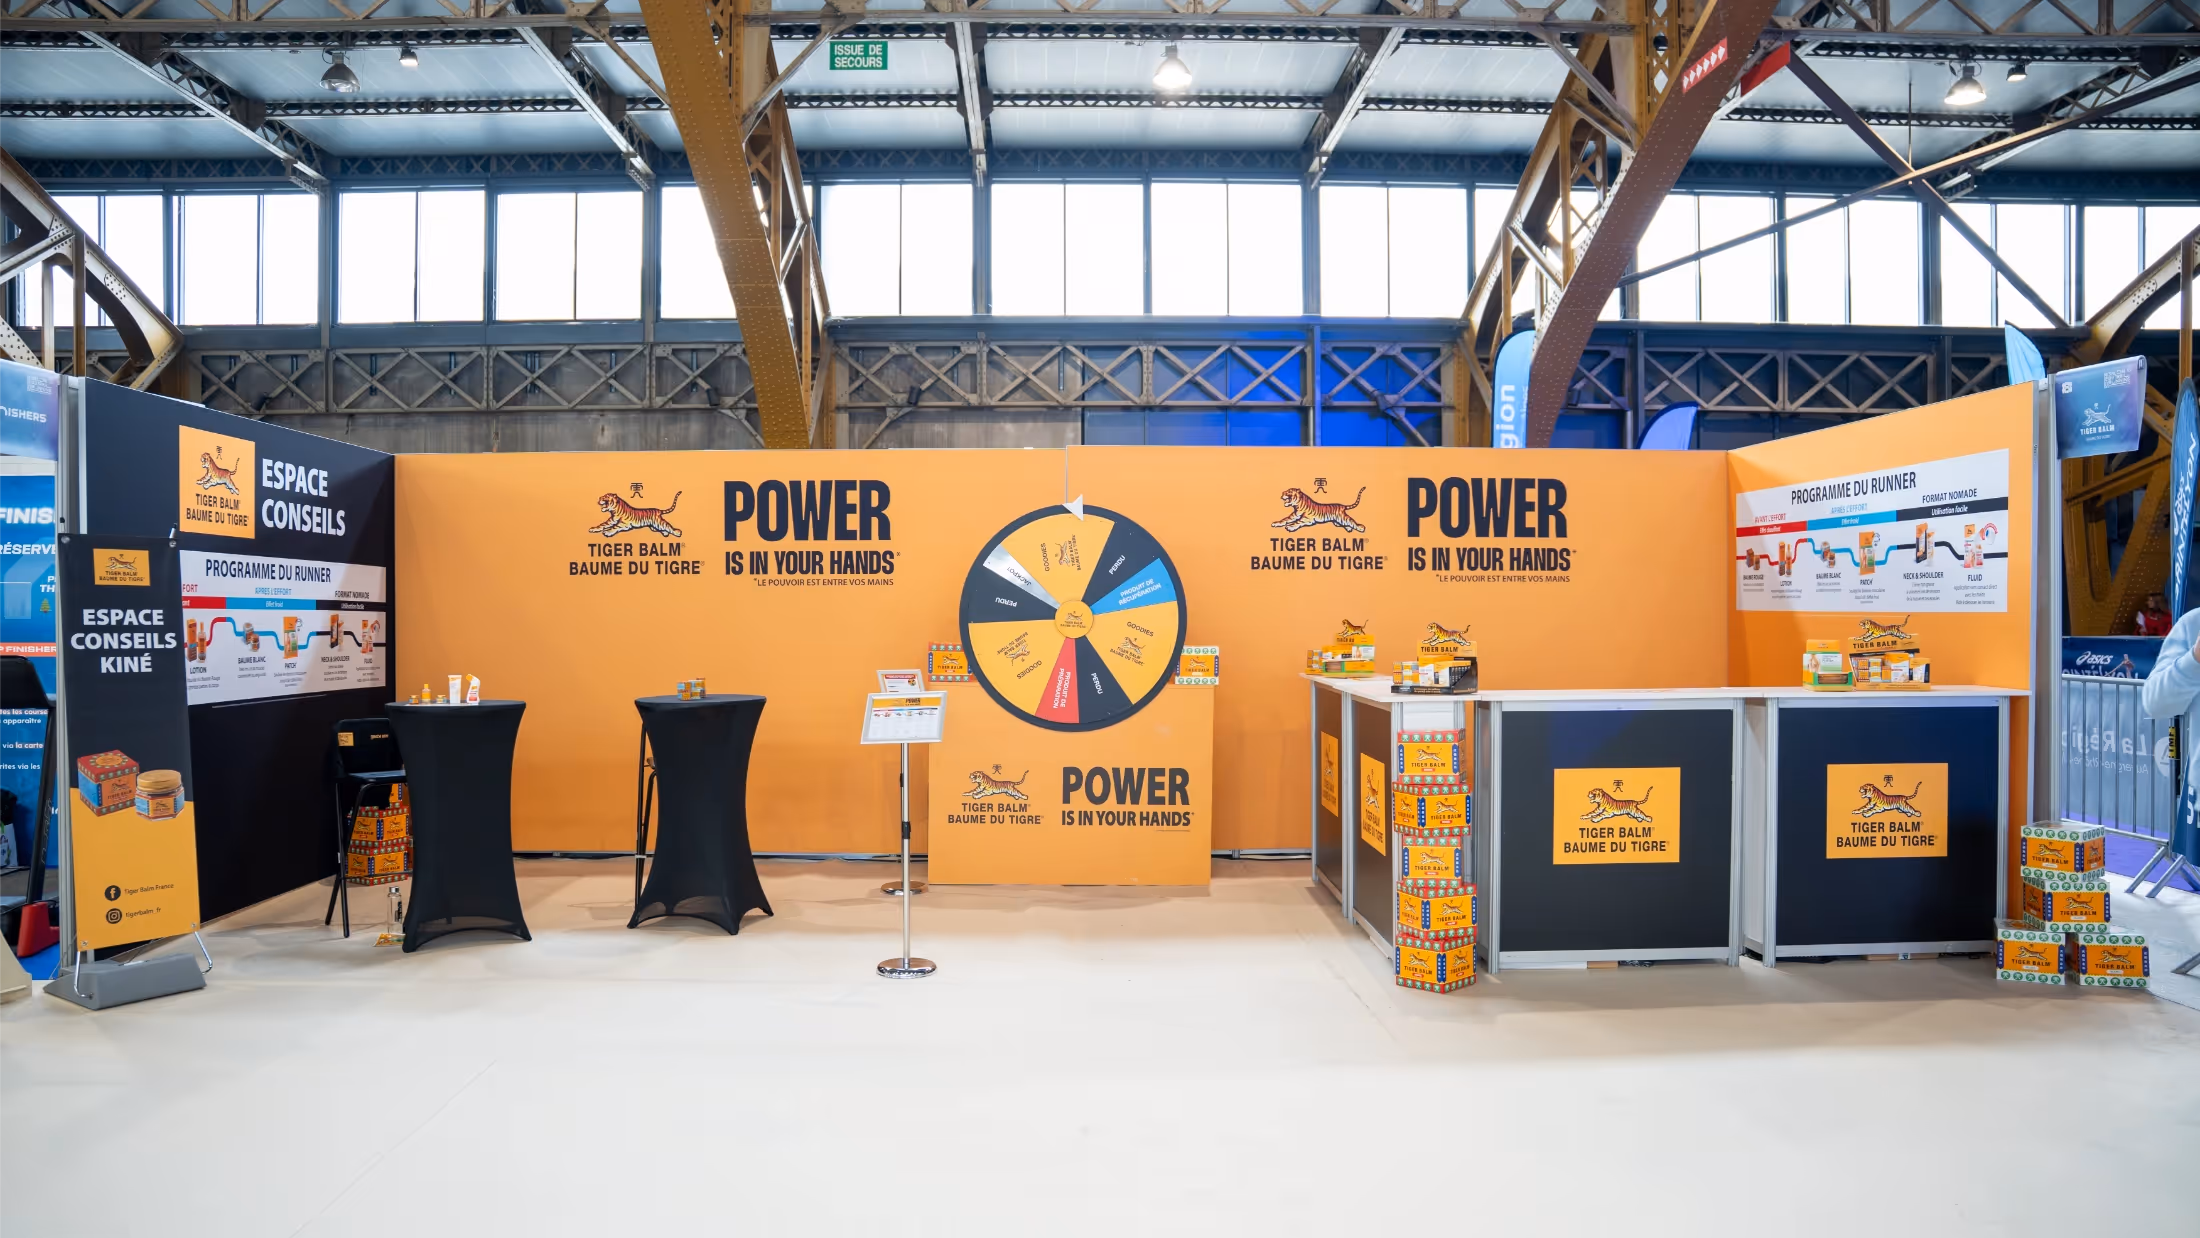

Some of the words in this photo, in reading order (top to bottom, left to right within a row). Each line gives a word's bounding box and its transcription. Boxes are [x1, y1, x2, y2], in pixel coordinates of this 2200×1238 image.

[834, 44, 864, 56] ISSUE
[869, 44, 883, 56] DE
[834, 56, 883, 68] SECOURS
[2080, 427, 2097, 435] TIGER
[2098, 424, 2115, 433] BALM
[262, 458, 328, 497] ESPACE
[1791, 481, 1851, 506] PROGRAMME
[1853, 479, 1869, 496] DU
[1871, 471, 1917, 494] RUNNER
[195, 493, 218, 508] TIGER
[1922, 492, 1947, 504] FORMAT
[1949, 488, 1978, 501] NOMADE
[724, 479, 892, 542] POWER
[1407, 476, 1568, 539] POWER
[1931, 506, 1955, 516] Utilisation
[1955, 505, 1968, 514] facile
[186, 507, 213, 523] BAUME
[214, 511, 225, 524] DU
[262, 498, 346, 537] CONSEILS
[1754, 515, 1768, 523] AVANT
[588, 543, 633, 557] TIGER
[1270, 538, 1316, 552] TIGER
[725, 551, 744, 575] IS
[749, 551, 768, 575] IN
[774, 550, 824, 575] YOUR
[1040, 542, 1050, 572] GOODIES
[1250, 556, 1305, 570] BAUME
[1311, 556, 1332, 570] DU
[1408, 546, 1426, 571] IS
[1432, 547, 1450, 571] IN
[1456, 547, 1504, 571] YOUR
[205, 558, 276, 580] PROGRAMME
[278, 564, 293, 581] DU
[294, 566, 331, 583] RUNNER
[569, 561, 622, 575] BAUME
[628, 561, 649, 575] DU
[1108, 555, 1126, 575] PERDU
[768, 578, 805, 586] POUVOIR
[806, 578, 821, 586] EST
[822, 578, 848, 586] ENTRE
[849, 578, 866, 586] VOS
[867, 578, 894, 586] MAINS
[1006, 566, 1032, 586] JACKPOT
[1903, 572, 1915, 580] NECK
[1919, 571, 1944, 579] SHOULDER
[335, 590, 352, 598] FORMAT
[352, 591, 370, 599] NOMADE
[1120, 581, 1145, 598] PRODUIT
[1145, 578, 1154, 586] DE
[994, 597, 1018, 607] PERDU
[82, 608, 165, 626] ESPACE
[1126, 621, 1154, 637] GOODIES
[70, 632, 178, 650] CONSEILS
[1876, 640, 1898, 648] BALM
[100, 652, 153, 674] KINÉ
[1016, 660, 1043, 680] GOODIES
[1062, 671, 1071, 698] PRODUIT
[1091, 672, 1103, 695] PERDU
[1060, 697, 1067, 708] DE
[2, 717, 42, 725] apparaître
[2, 741, 14, 749] via
[15, 740, 23, 749] la
[17, 762, 29, 770] via
[30, 762, 41, 770] les
[1062, 766, 1190, 806] POWER
[961, 802, 994, 813] TIGER
[948, 814, 986, 824] BAUME
[990, 814, 1005, 824] DU
[1061, 810, 1075, 826] IS
[1078, 810, 1093, 826] IN
[1096, 810, 1136, 826] YOUR
[1579, 827, 1614, 839] TIGER
[1850, 822, 1885, 834] TIGER
[1564, 841, 1606, 853] BAUME
[1610, 841, 1627, 853] DU
[1836, 836, 1877, 848] BAUME
[1881, 836, 1897, 848] DU
[124, 887, 139, 896] Tiger
[155, 883, 175, 891] France
